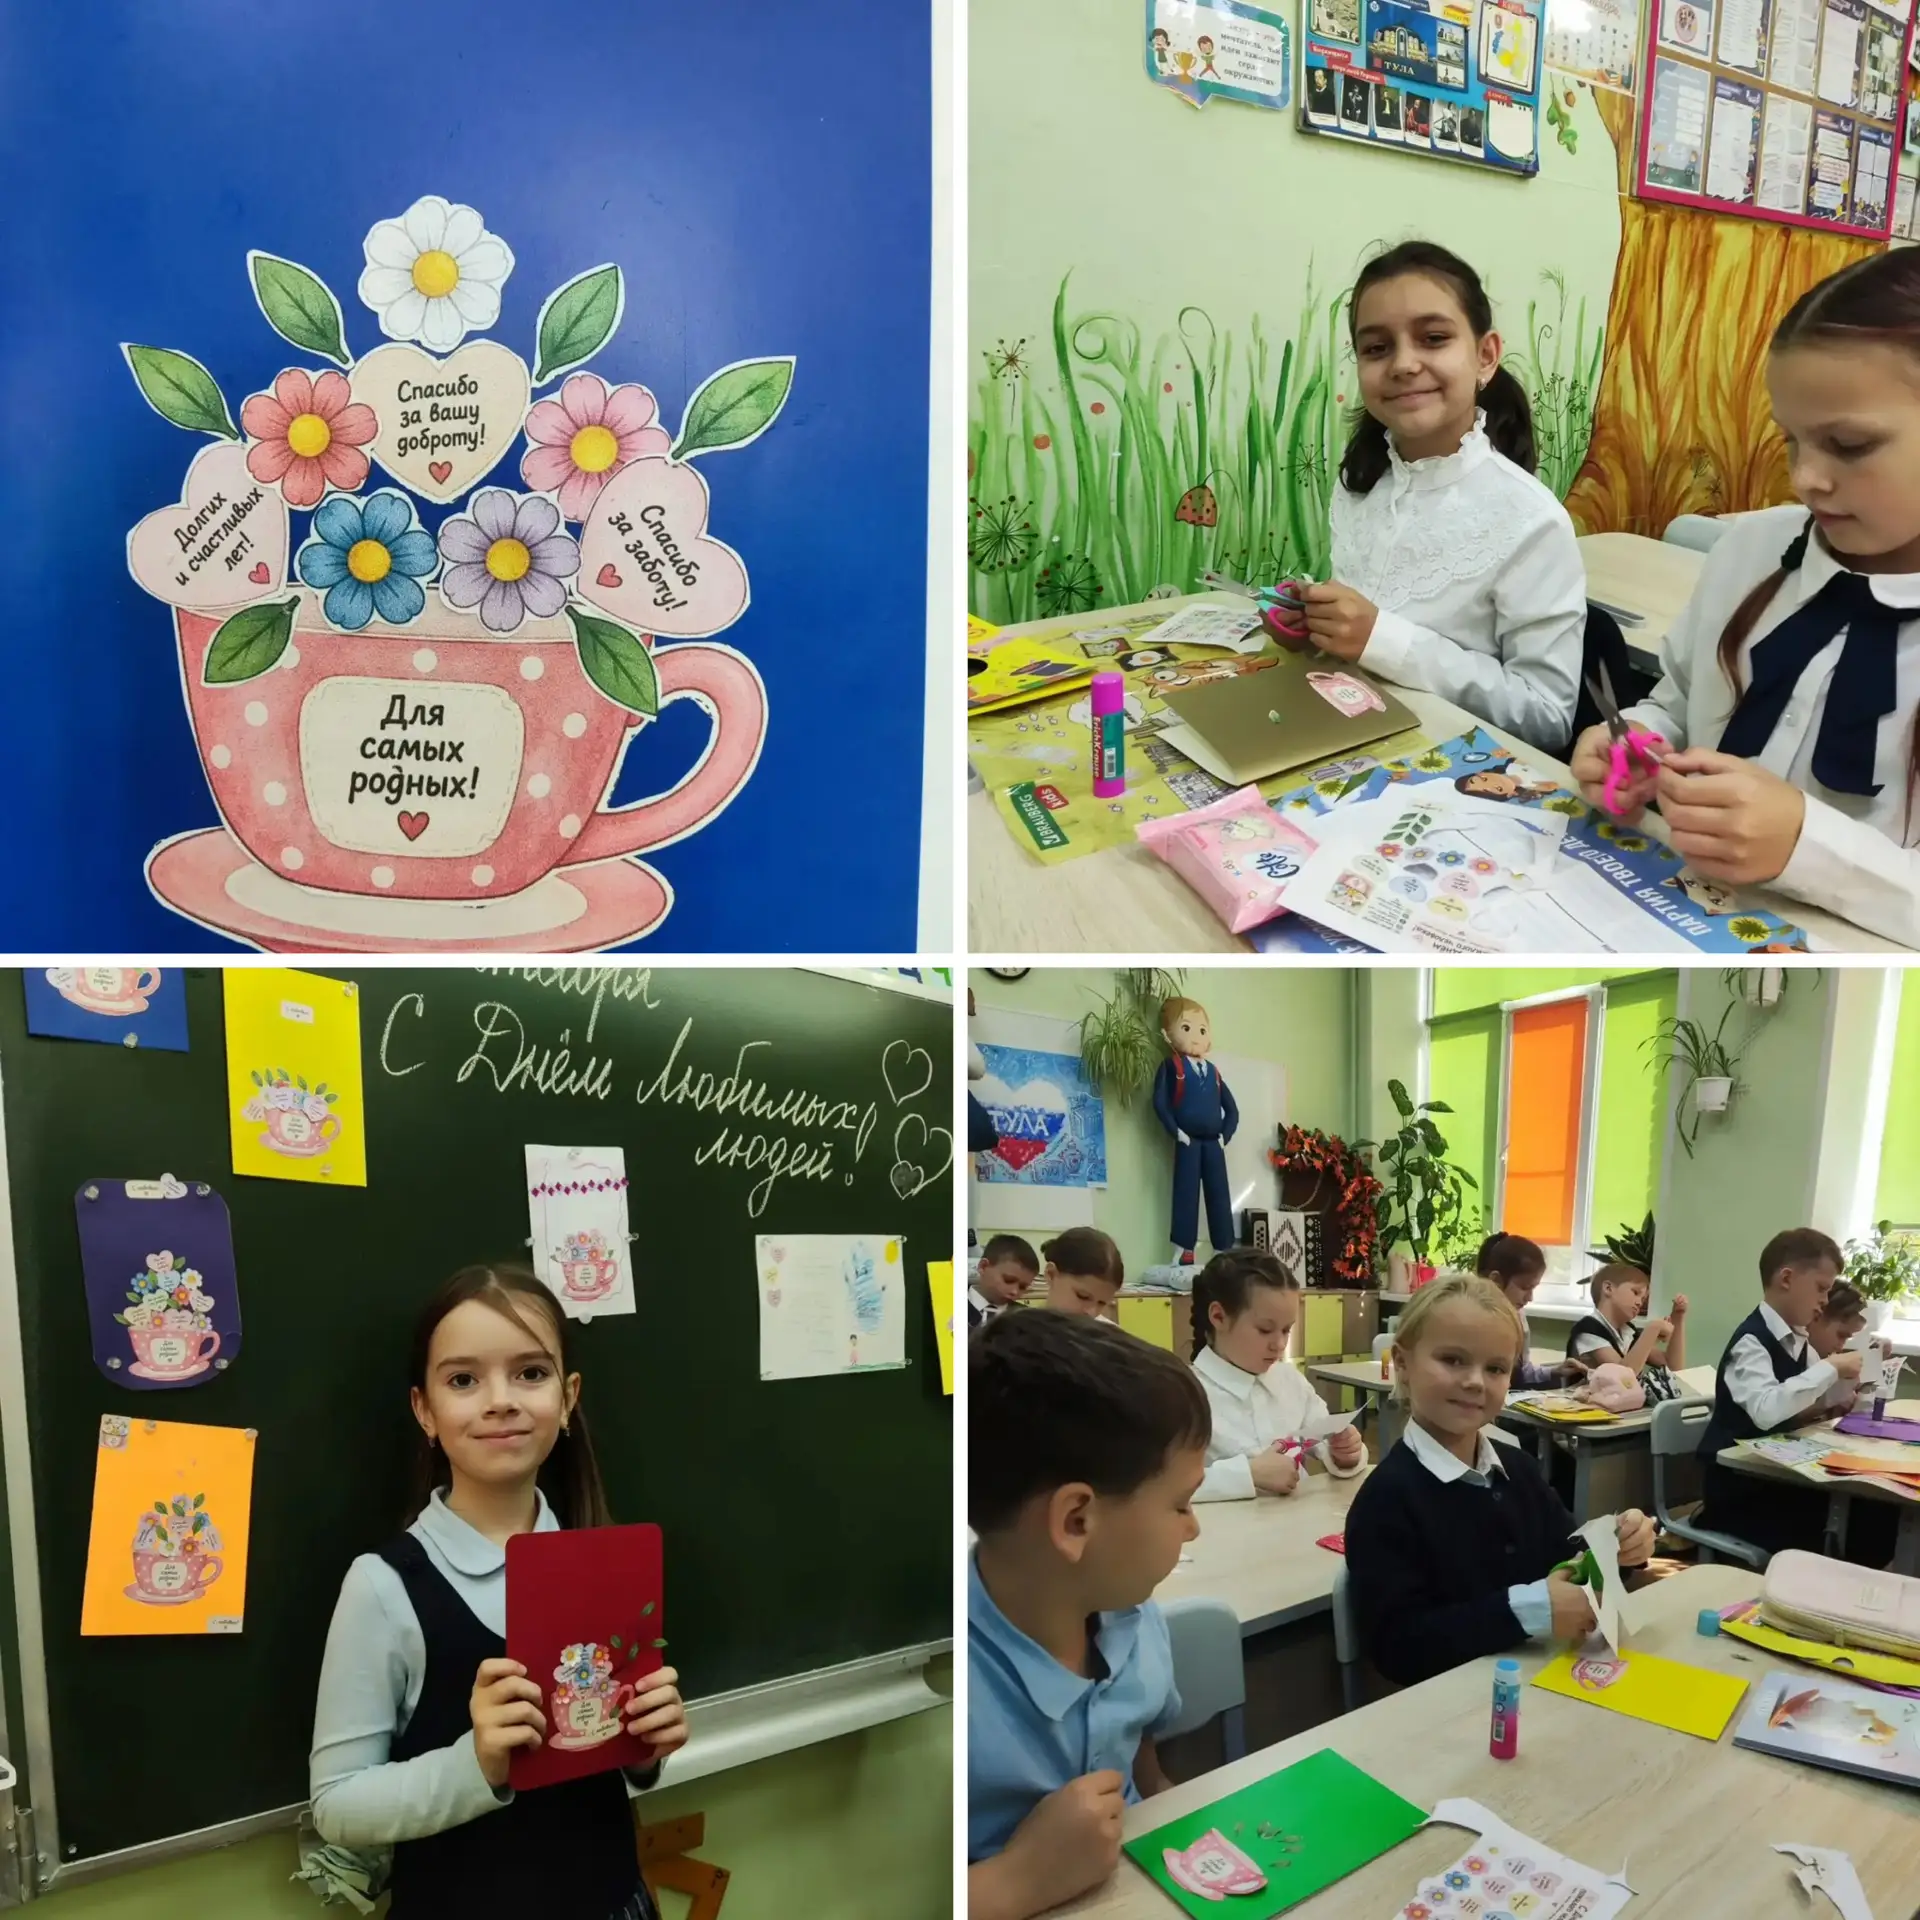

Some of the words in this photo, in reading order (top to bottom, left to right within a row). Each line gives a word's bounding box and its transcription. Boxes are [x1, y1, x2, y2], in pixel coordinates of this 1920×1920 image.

[1384, 61, 1415, 76] ТУЛА
[397, 378, 478, 403] Спасибо
[400, 407, 425, 425] за
[431, 403, 480, 427] вашу
[397, 424, 486, 456] доброту!
[173, 491, 227, 553] Долгих
[175, 572, 189, 587] и
[186, 487, 264, 573] счастливых
[224, 531, 257, 572] лет!
[607, 511, 632, 535] за
[622, 529, 688, 613] заботу!
[638, 504, 701, 588] Спасибо
[380, 695, 446, 729] Для
[359, 735, 465, 763] самых
[1092, 716, 1101, 778] ErichKrause
[348, 768, 479, 804] родных!
[1023, 793, 1052, 840] BRAUBERG
[1578, 849, 1643, 888] ТВОЕГО
[1634, 887, 1713, 936] ПАРТИЯ
[380, 992, 427, 1076] С
[456, 1001, 613, 1100] Днём
[636, 1016, 858, 1129] Любимых
[988, 1109, 1049, 1137] ТУЛА
[694, 1101, 877, 1218] людей!
